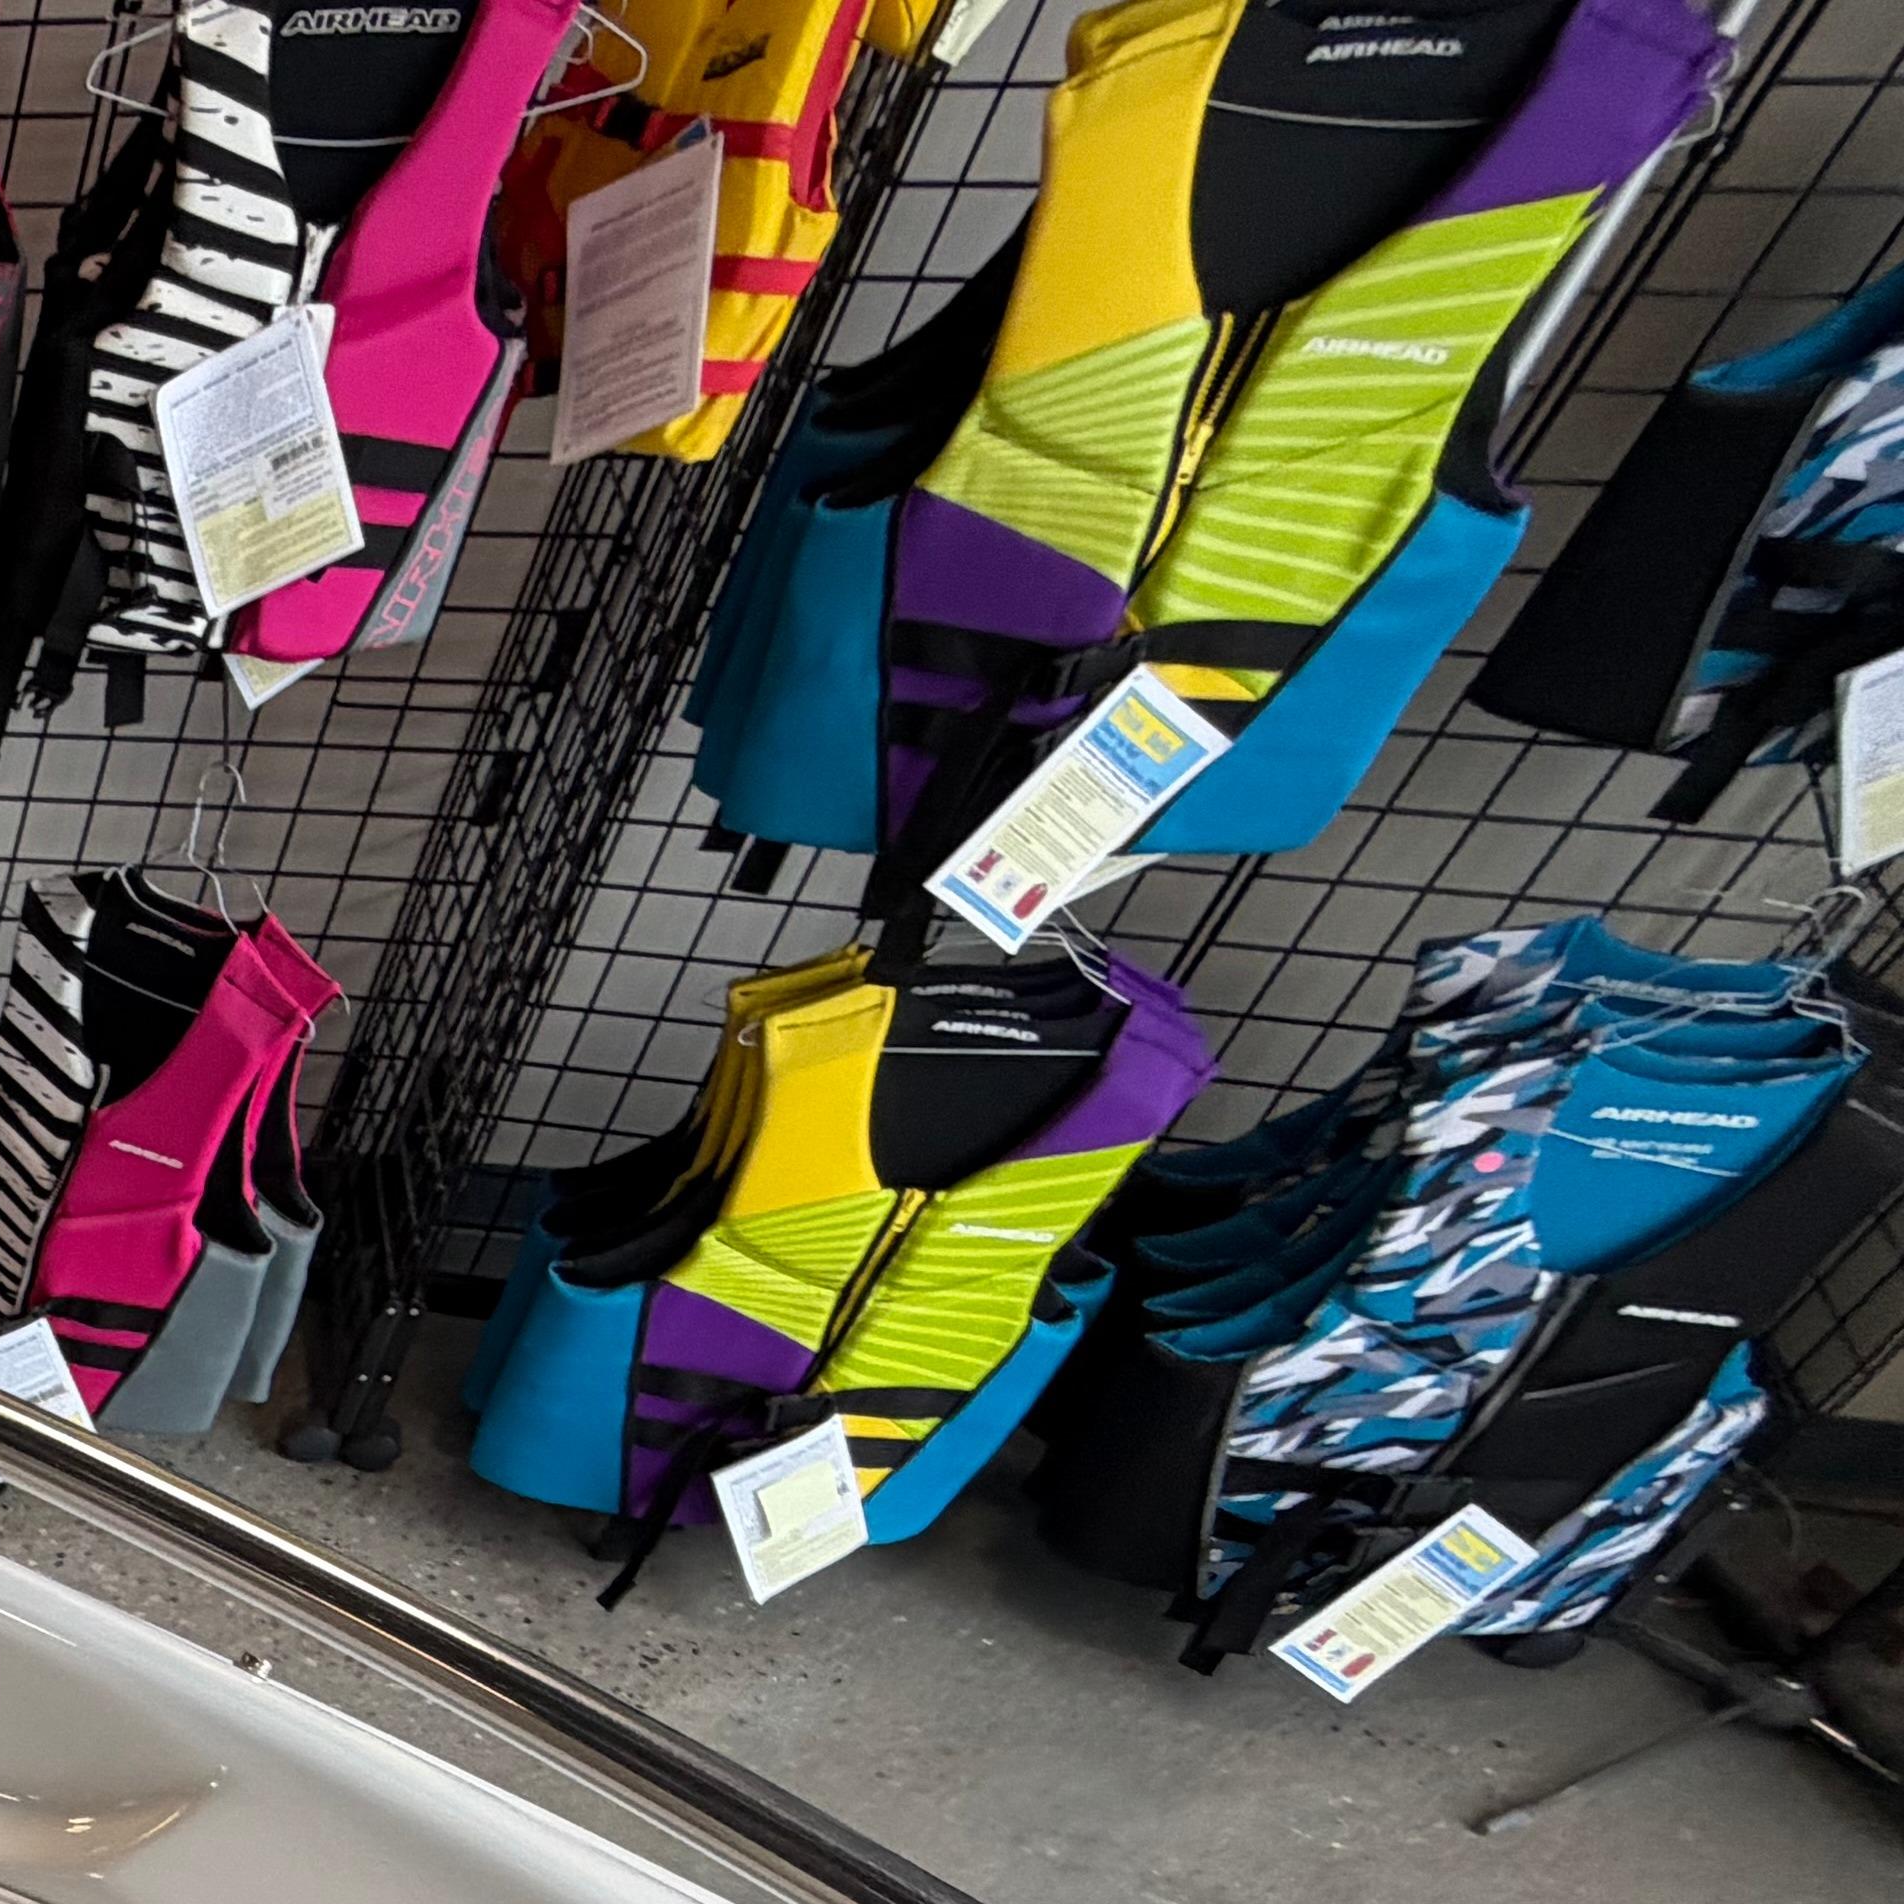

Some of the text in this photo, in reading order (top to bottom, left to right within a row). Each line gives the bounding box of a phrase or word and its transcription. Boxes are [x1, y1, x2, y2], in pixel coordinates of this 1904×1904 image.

[280, 7, 461, 37] AIRHEAD
[1304, 38, 1464, 64] AIRHEAD
[1300, 336, 1448, 366] AIRHEAD
[930, 1020, 1041, 1042] AIRHEAD
[1591, 1106, 1760, 1129] AIRHEAD
